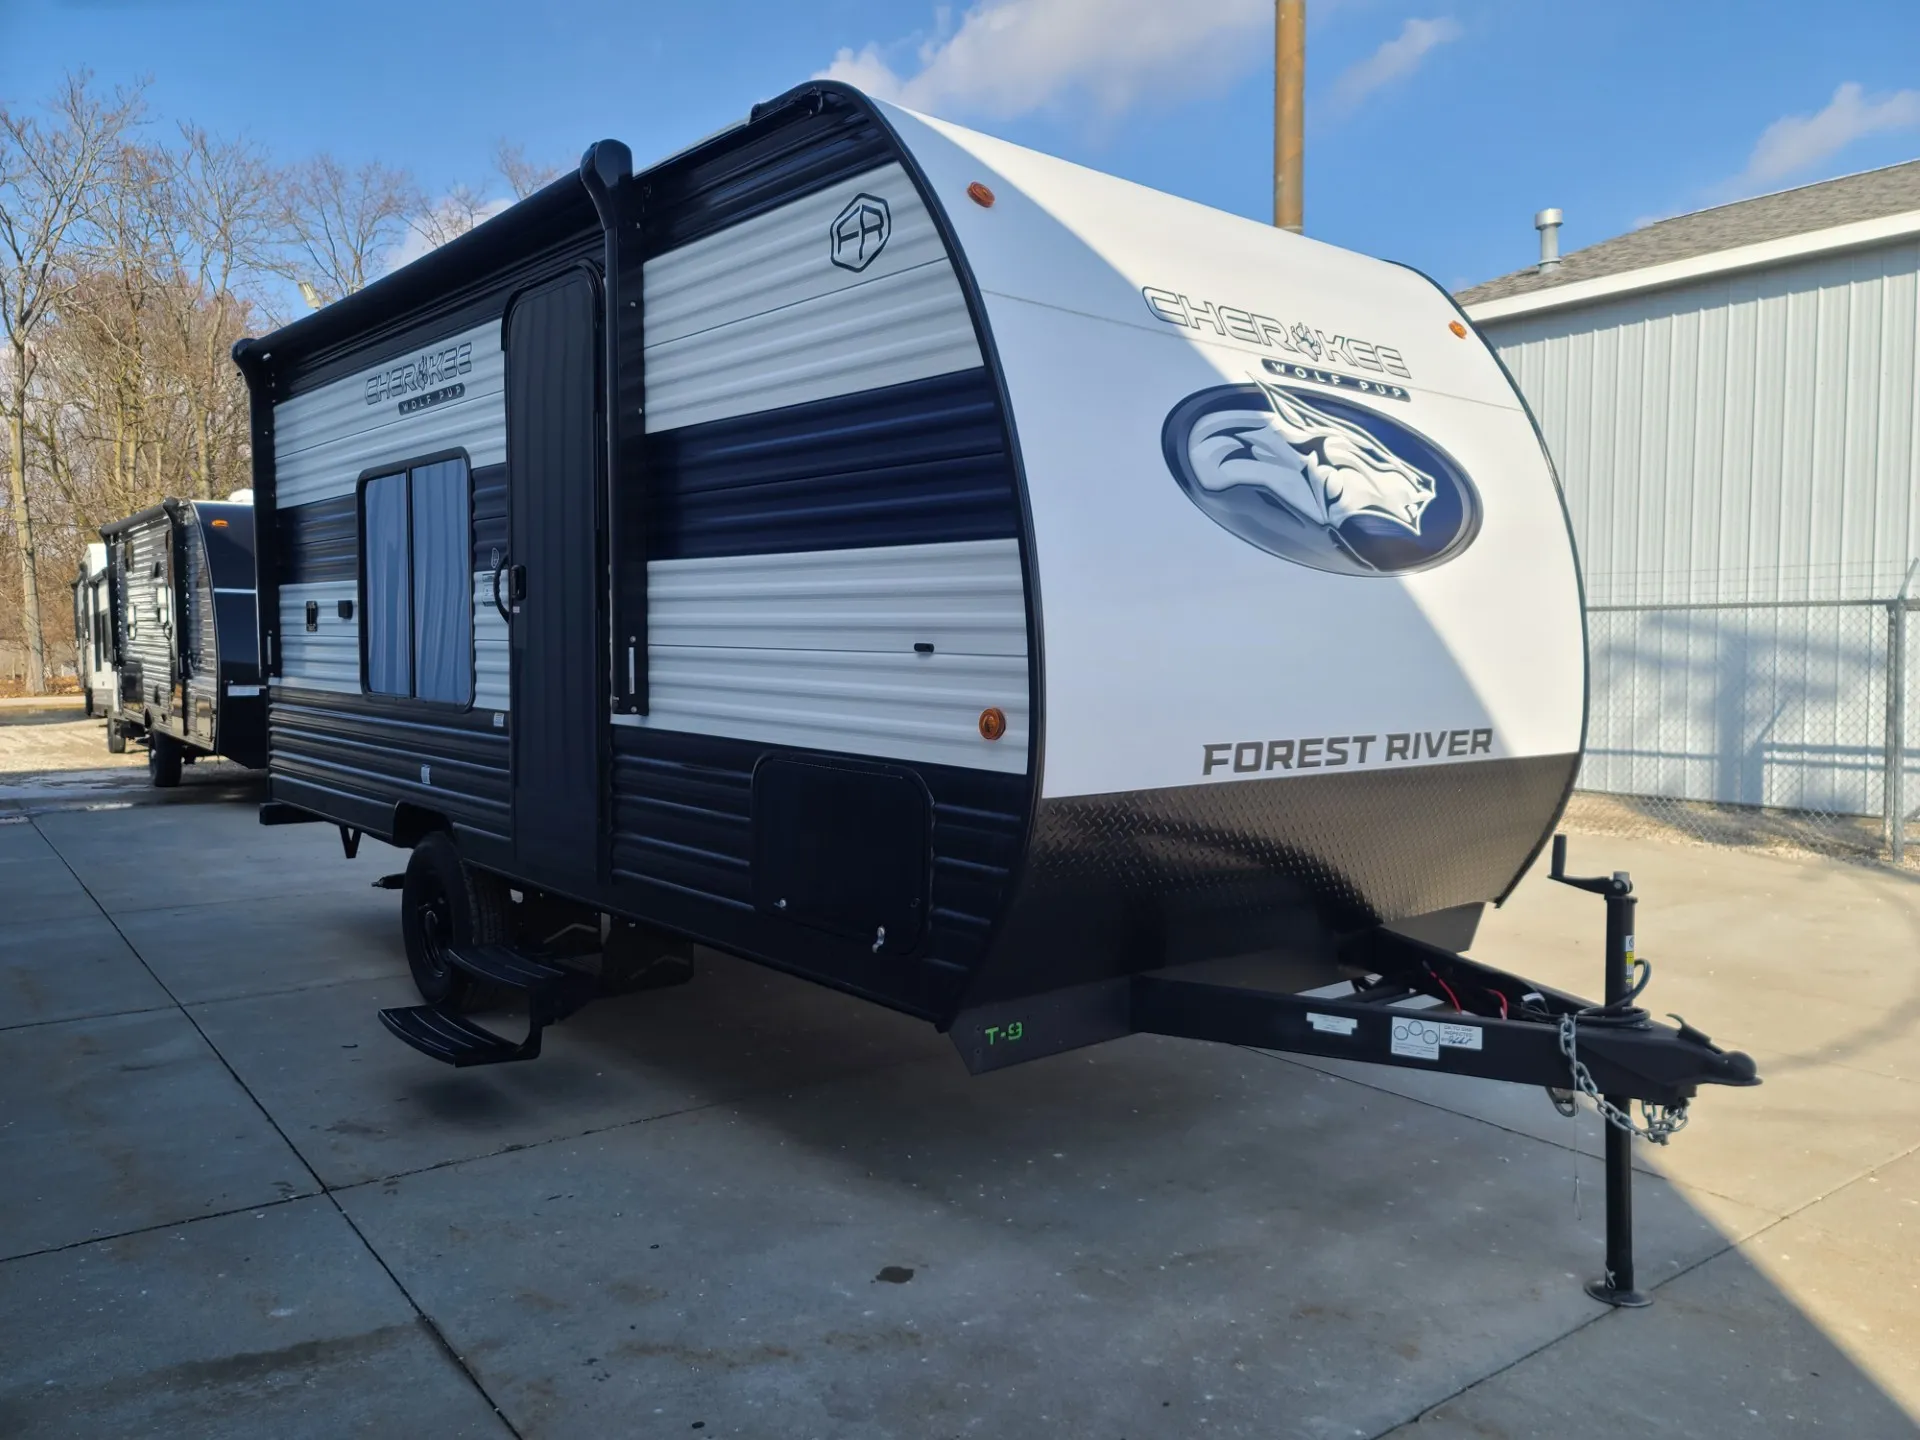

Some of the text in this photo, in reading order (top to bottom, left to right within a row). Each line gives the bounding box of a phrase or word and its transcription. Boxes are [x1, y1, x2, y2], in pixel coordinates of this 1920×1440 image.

[1271, 361, 1403, 398] WOLF PUP
[402, 385, 462, 412] WOLF PUP
[1202, 727, 1494, 776] FOREST RIVER
